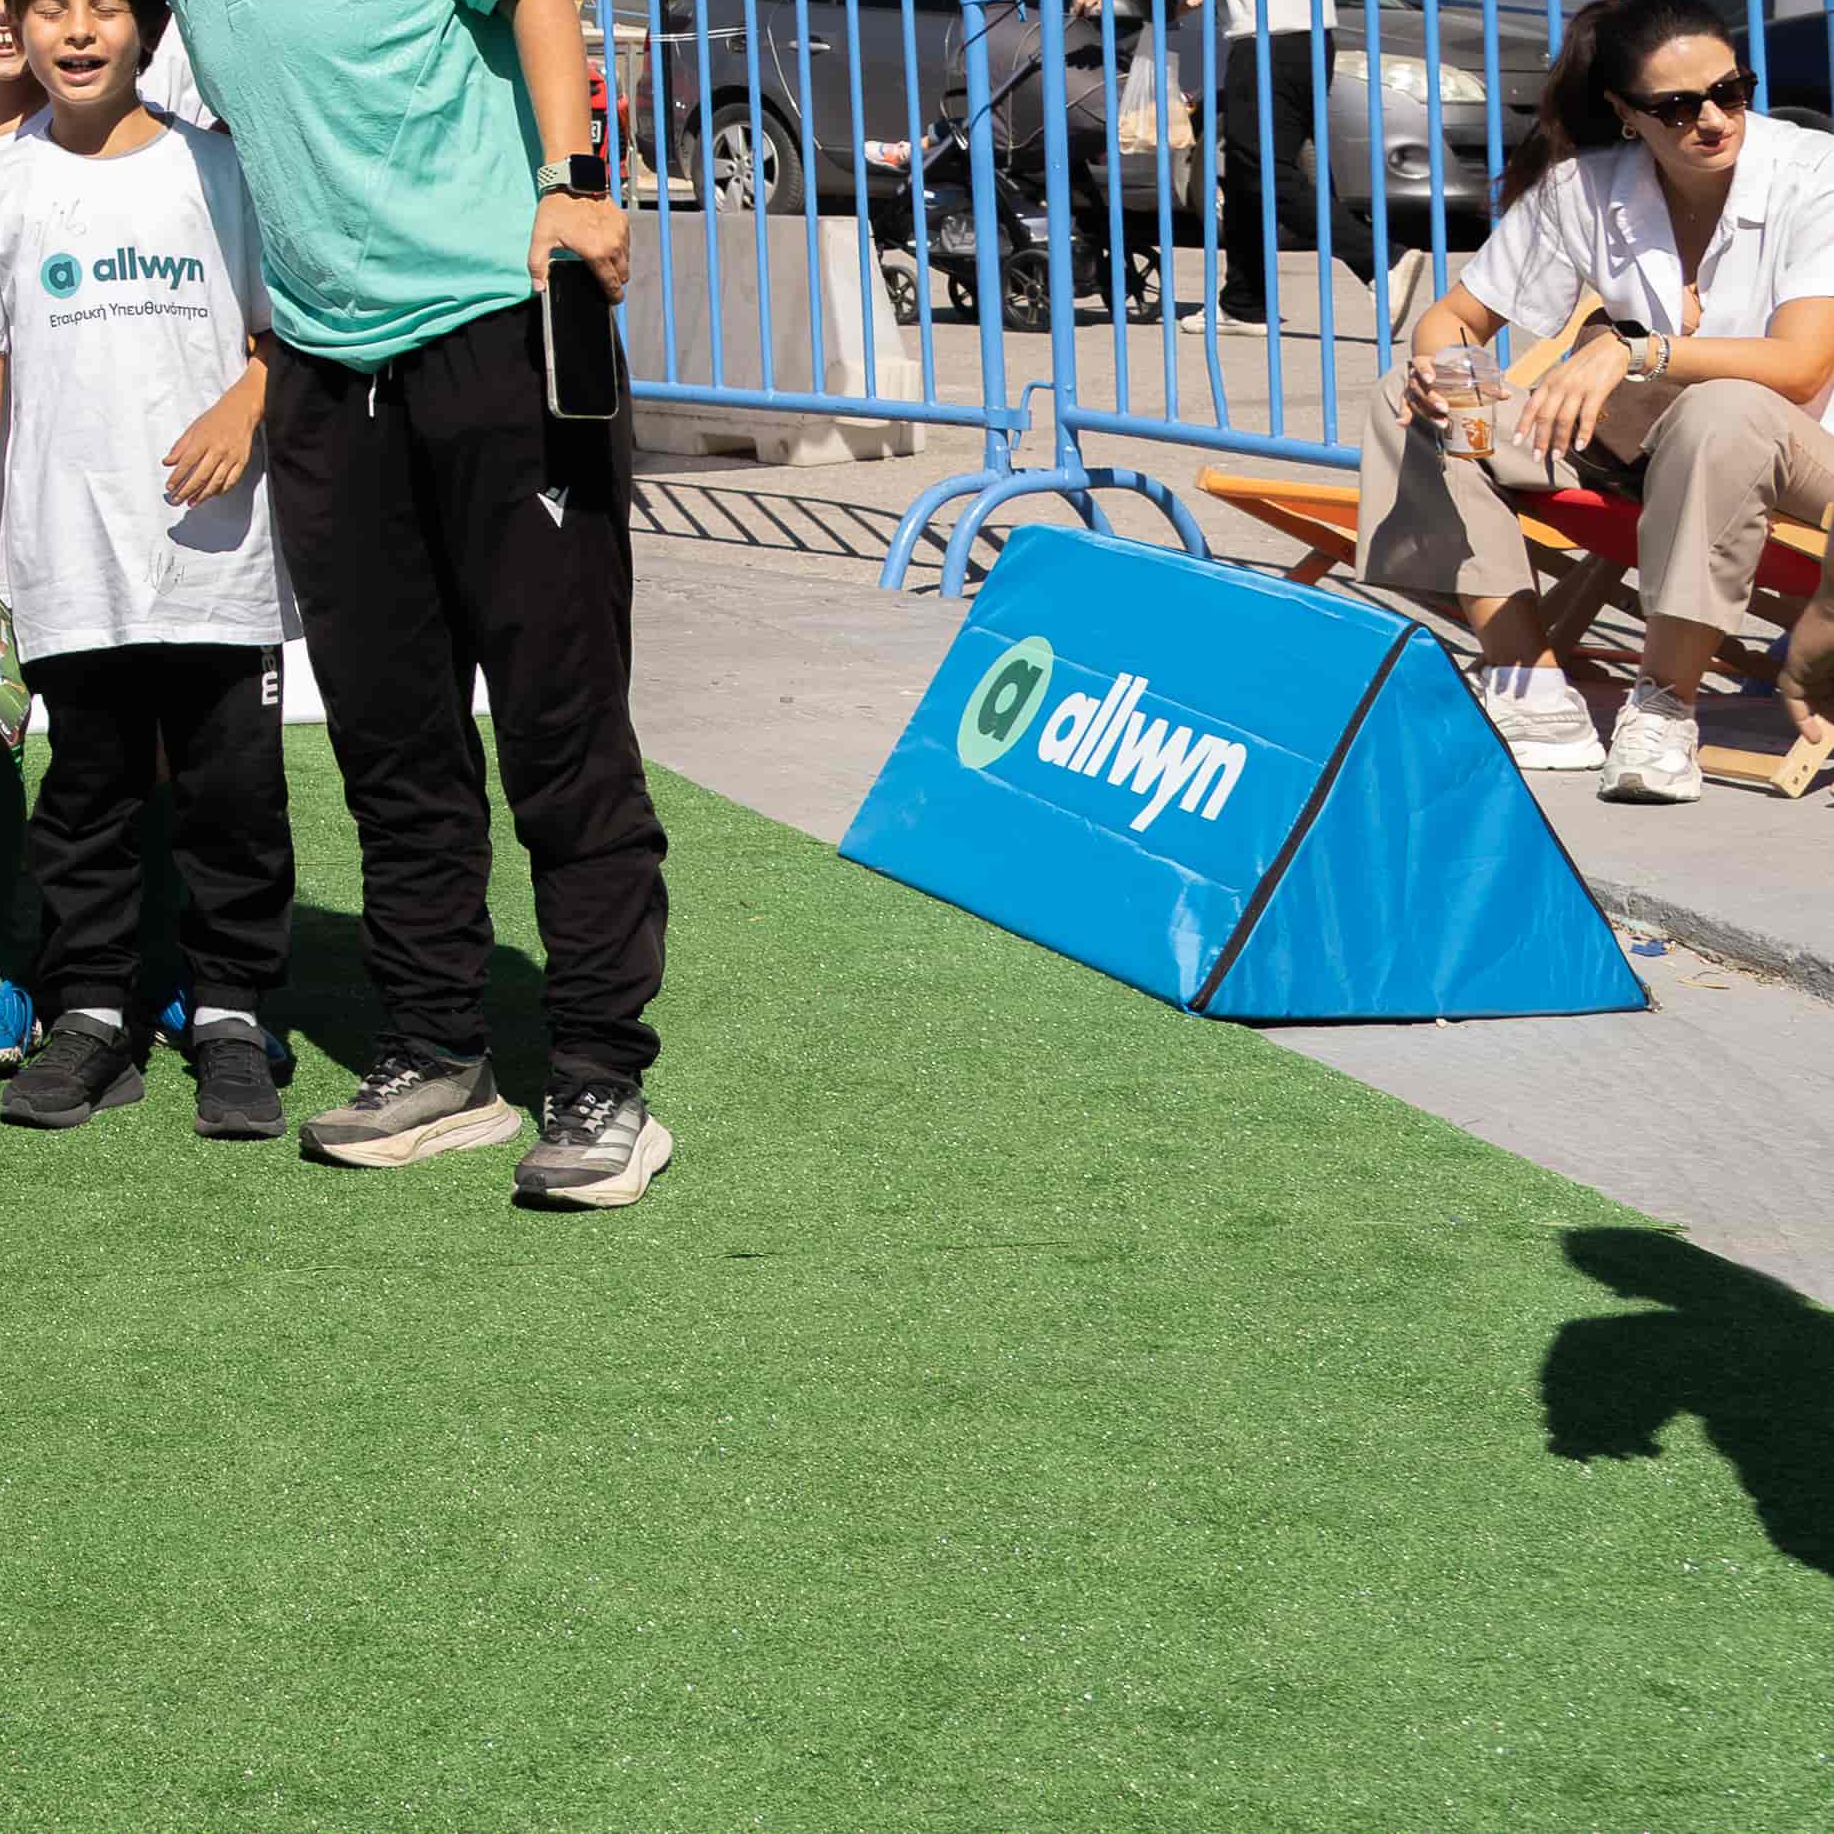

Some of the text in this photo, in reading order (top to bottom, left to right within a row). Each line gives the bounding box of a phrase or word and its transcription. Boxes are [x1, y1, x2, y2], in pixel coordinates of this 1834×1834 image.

[92, 246, 205, 291] allwyn
[49, 301, 209, 328] Εταιρική Υπευθυνότητα
[1037, 672, 1248, 833] allwyn
